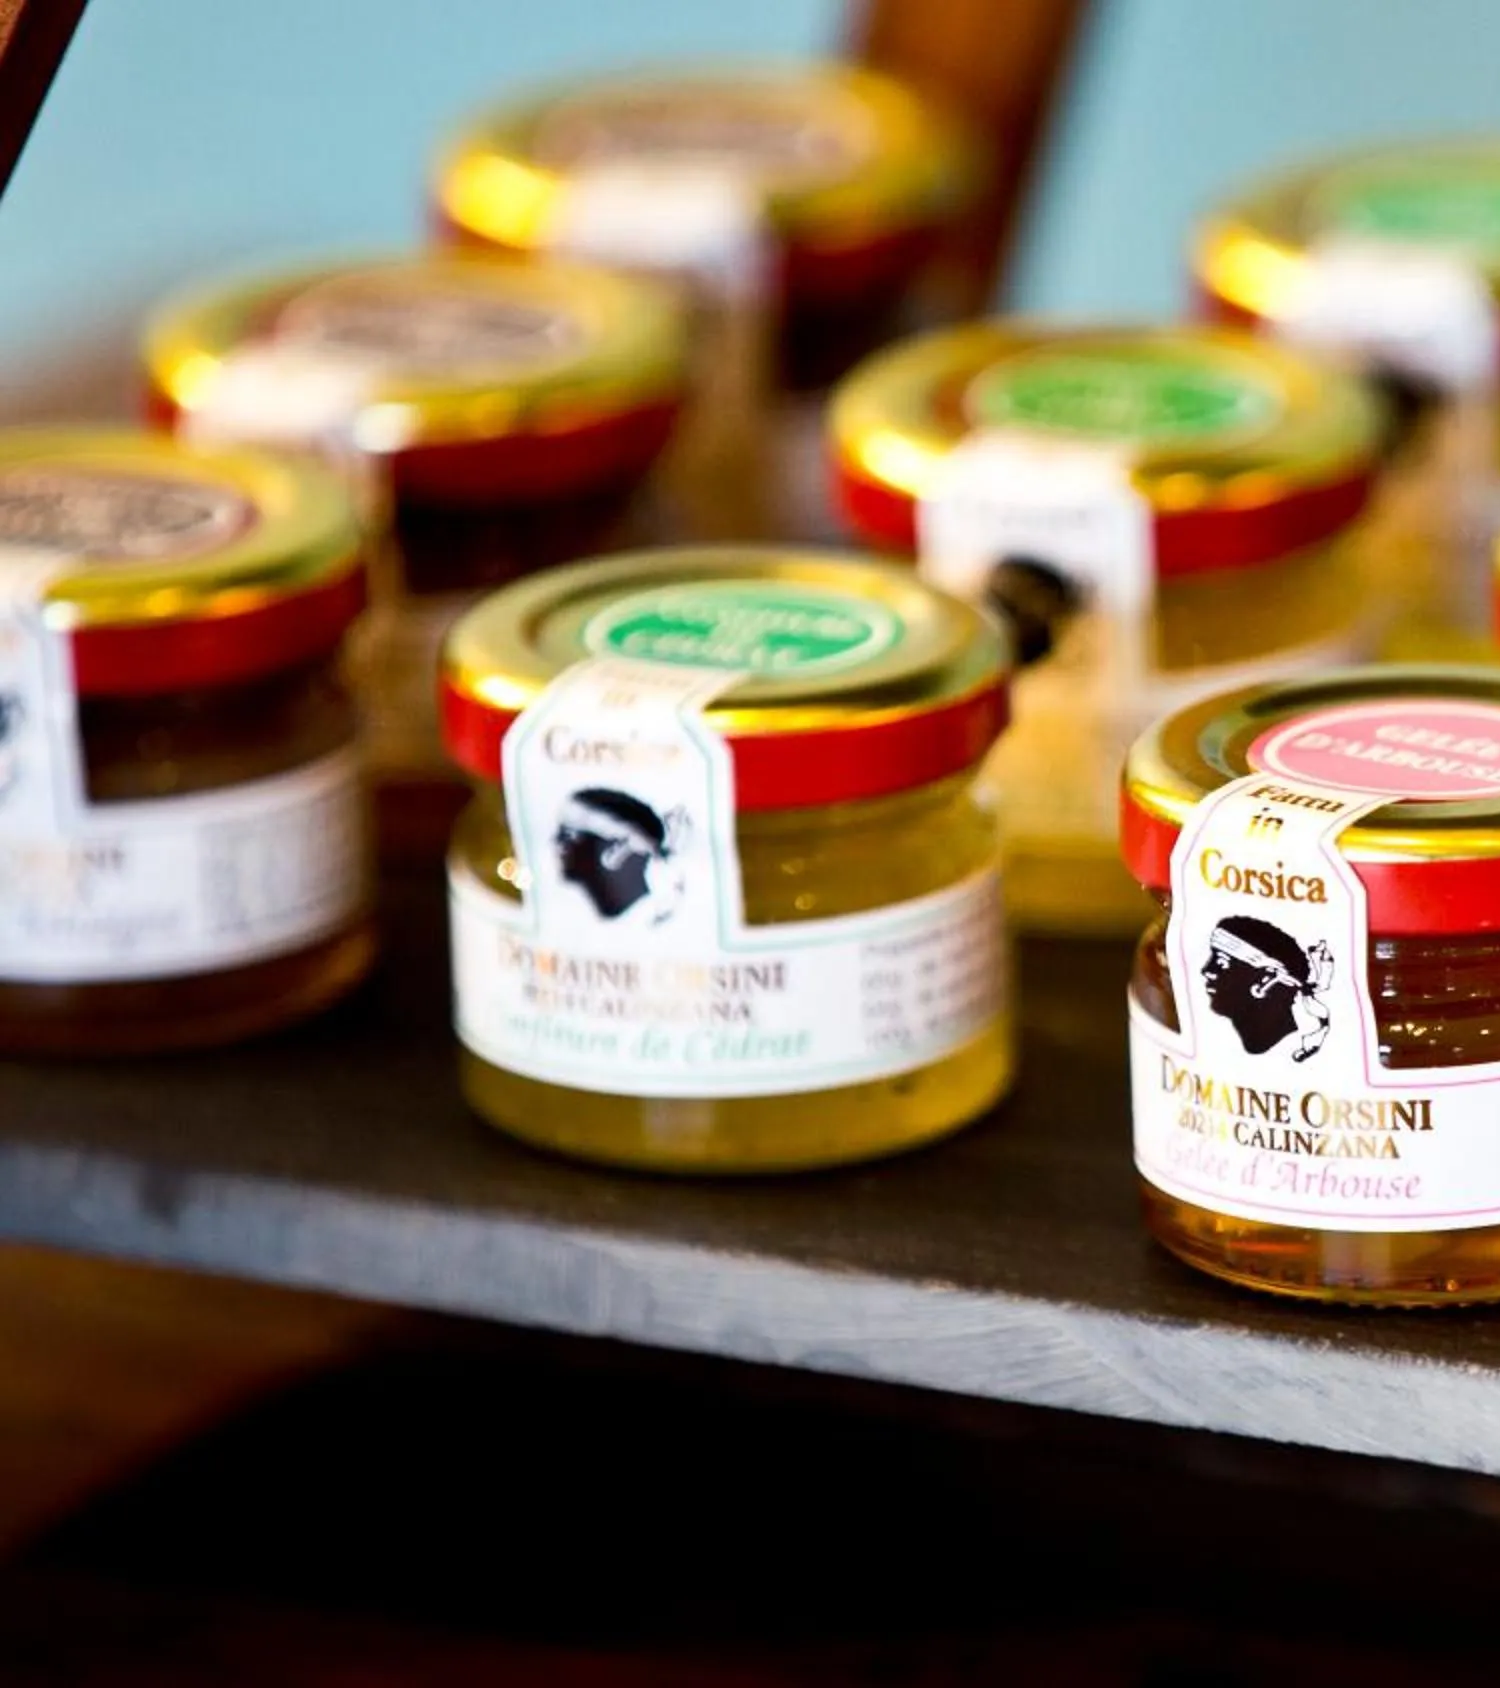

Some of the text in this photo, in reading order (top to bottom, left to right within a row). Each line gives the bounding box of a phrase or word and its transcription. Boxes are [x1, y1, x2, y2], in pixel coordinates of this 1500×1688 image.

[1246, 807, 1284, 842] in
[1200, 847, 1327, 903] Corsica
[1161, 1054, 1435, 1131] DOMAINE ORSINI
[1234, 1121, 1401, 1159] CALINZANA
[1241, 1153, 1422, 1201] d'Arbouse
